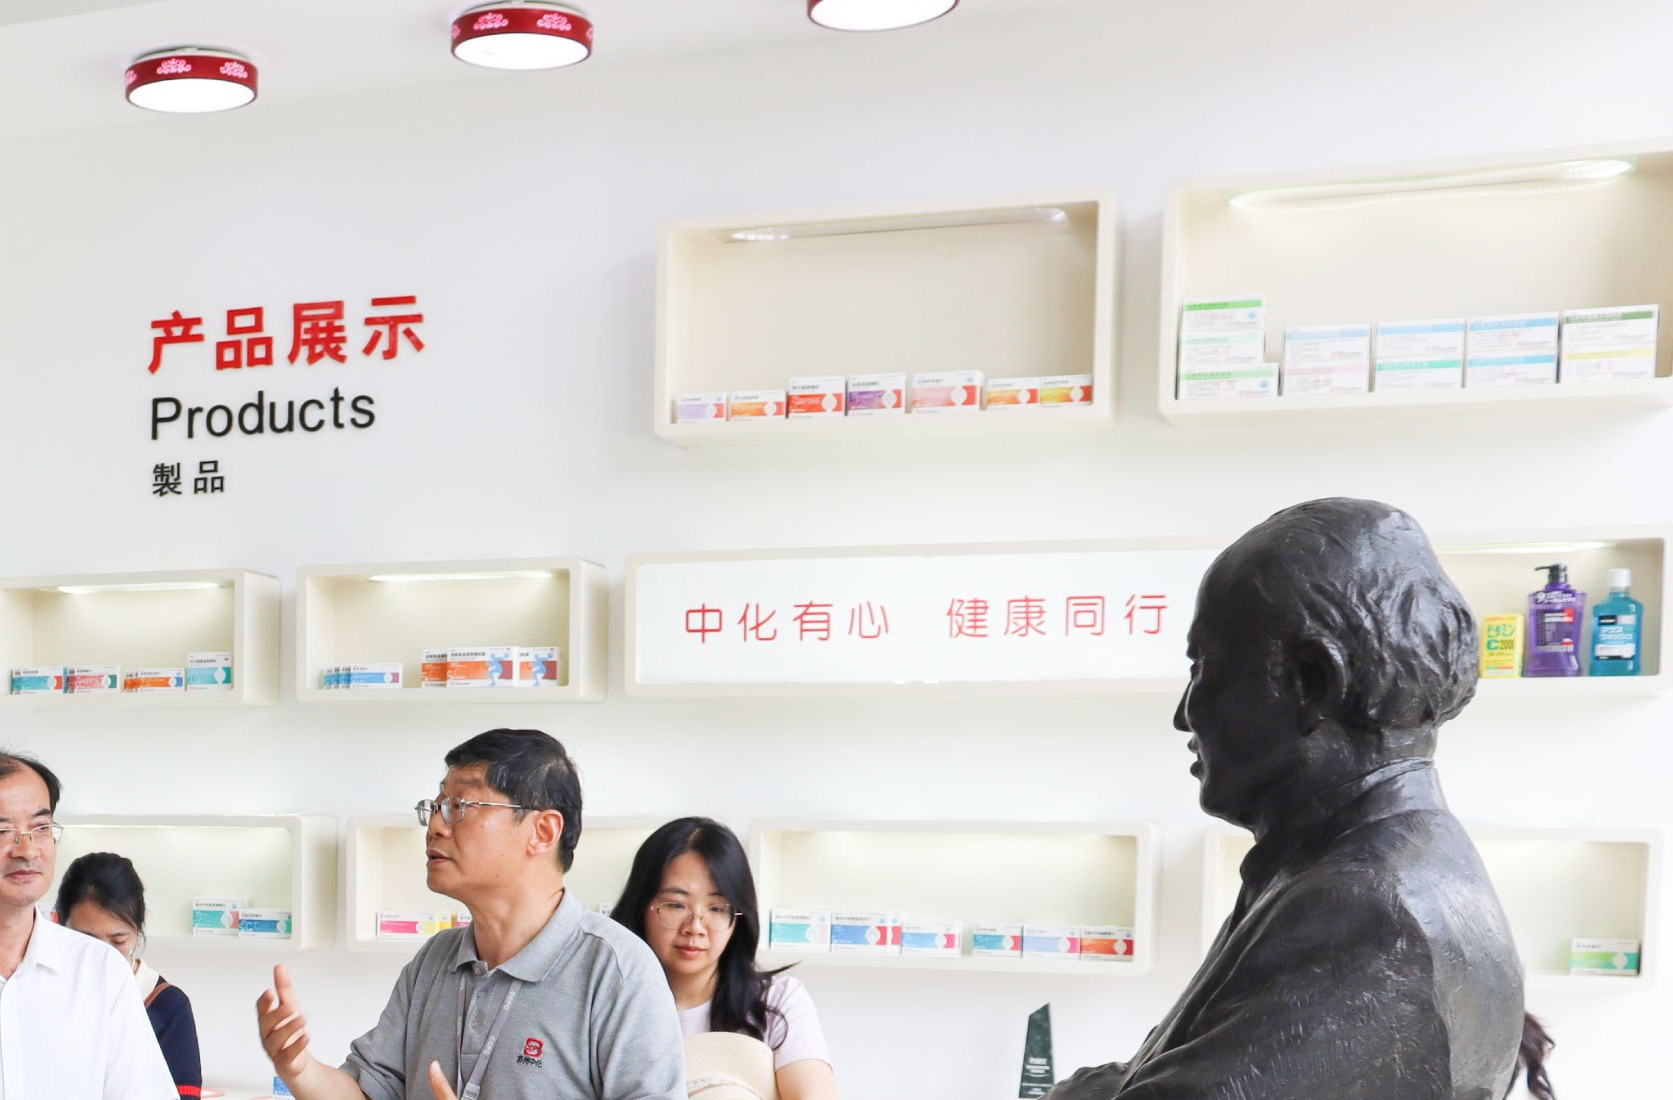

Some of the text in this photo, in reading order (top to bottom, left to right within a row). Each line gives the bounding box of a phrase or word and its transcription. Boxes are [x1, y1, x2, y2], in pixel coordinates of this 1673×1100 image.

[148, 295, 425, 375] 产品展示
[151, 386, 376, 440] Products
[152, 460, 225, 497] 製品
[685, 593, 1169, 644] 中化有心 健康同行
